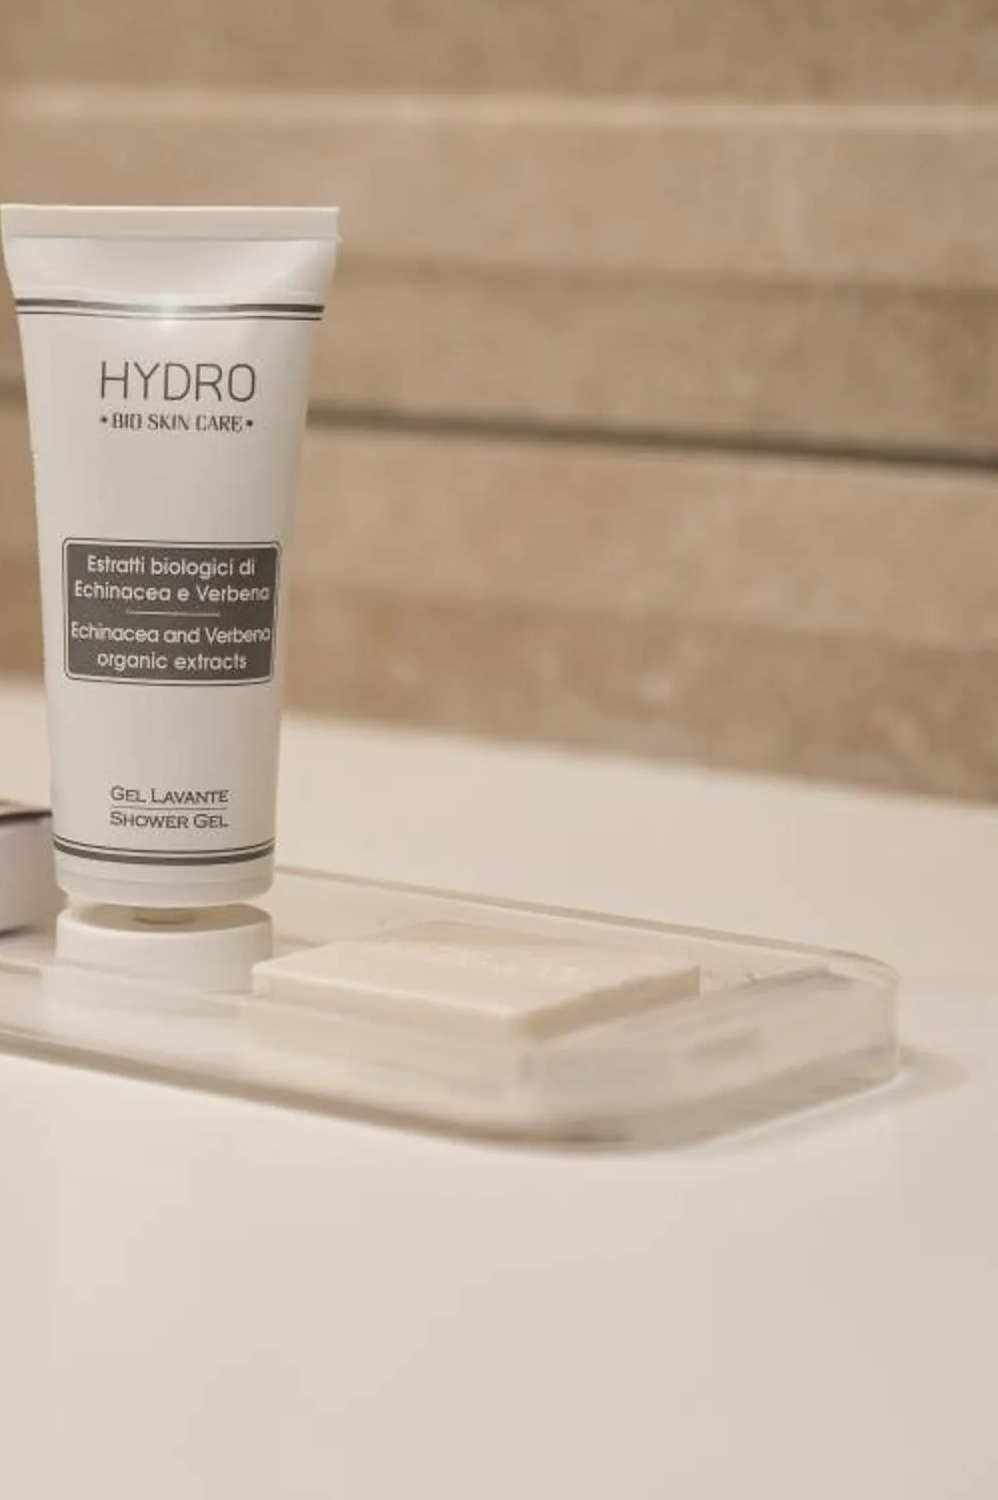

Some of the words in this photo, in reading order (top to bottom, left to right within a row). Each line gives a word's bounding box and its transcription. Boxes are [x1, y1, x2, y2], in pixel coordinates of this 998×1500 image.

[101, 361, 256, 402] HYDRO
[112, 412, 143, 429] BIO
[147, 413, 190, 431] SKIN
[195, 414, 243, 432] CARE
[87, 554, 145, 574] Estratti
[151, 556, 233, 580] biologici
[239, 558, 255, 575] di
[74, 580, 171, 601] Echinacea
[177, 586, 190, 601] e
[196, 584, 270, 602] Verbena
[71, 621, 159, 642] Echinacea
[163, 627, 201, 644] and
[205, 627, 271, 644] Verbena
[97, 652, 167, 672] organic
[174, 653, 247, 670] extracts
